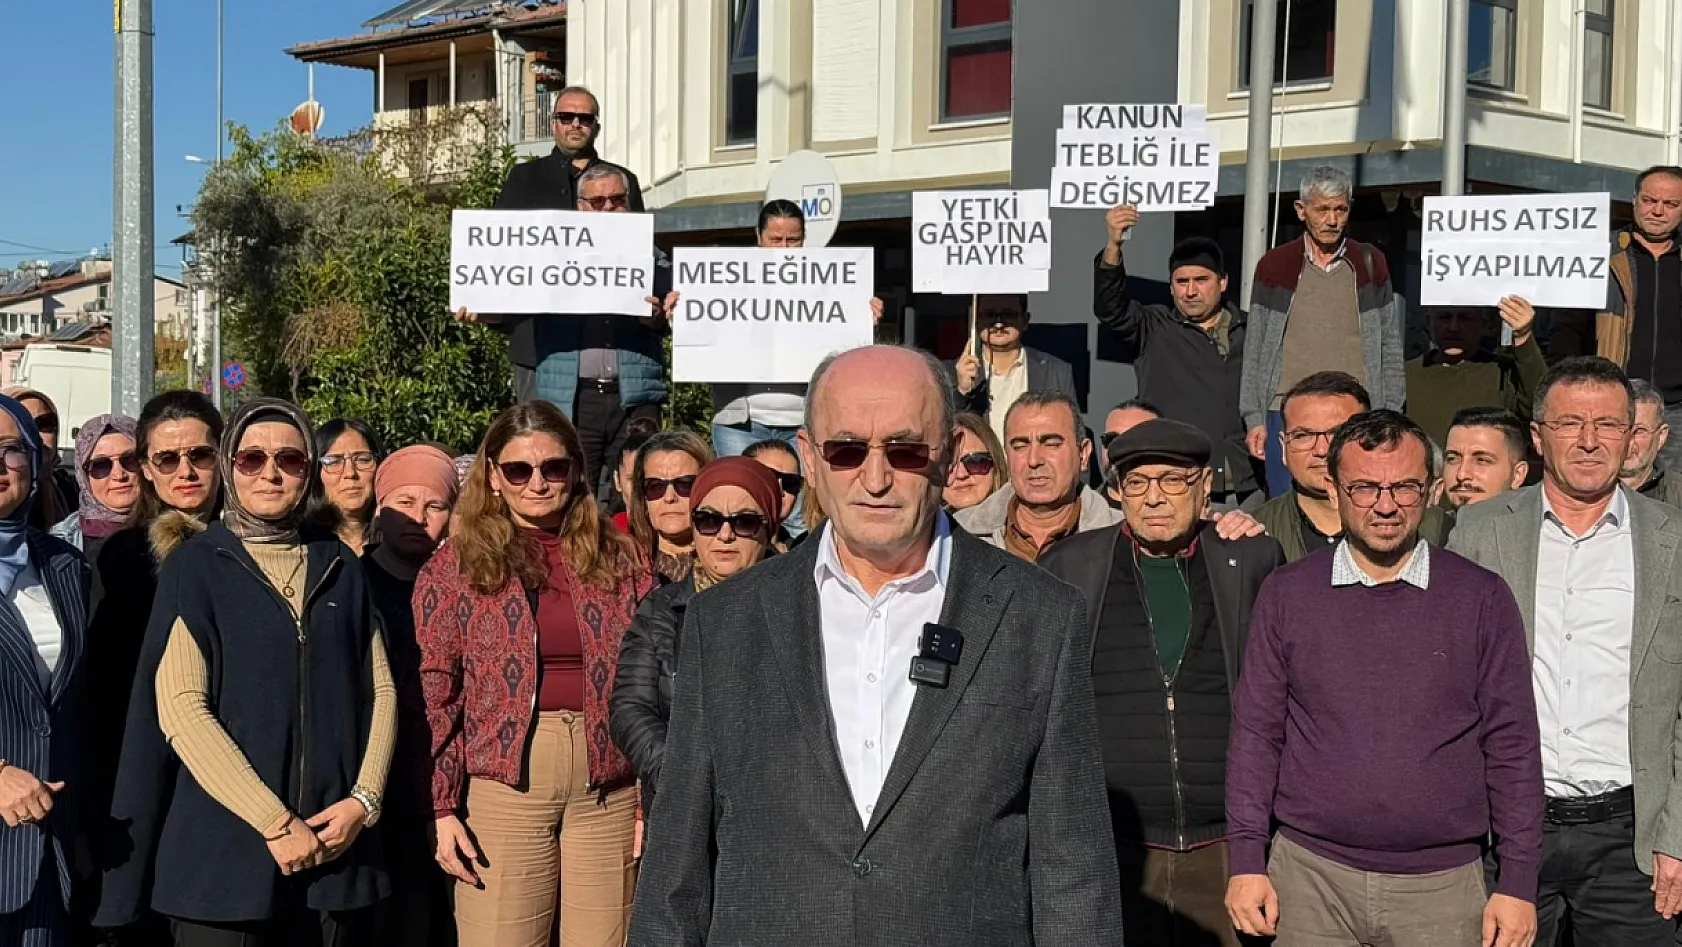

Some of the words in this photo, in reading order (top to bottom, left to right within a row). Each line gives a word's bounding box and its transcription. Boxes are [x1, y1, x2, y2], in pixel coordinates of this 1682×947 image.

[1077, 105, 1182, 129] KANUN
[1061, 137, 1158, 167] TEBLİĞ
[1170, 137, 1210, 167] İLE
[942, 192, 1017, 221] YETKİ
[468, 226, 594, 247] RUHSATA
[946, 245, 1023, 265] HAYIR
[455, 265, 533, 286] SAYGI
[542, 261, 645, 288] GÖSTER
[685, 299, 847, 323] DOKUNMA
